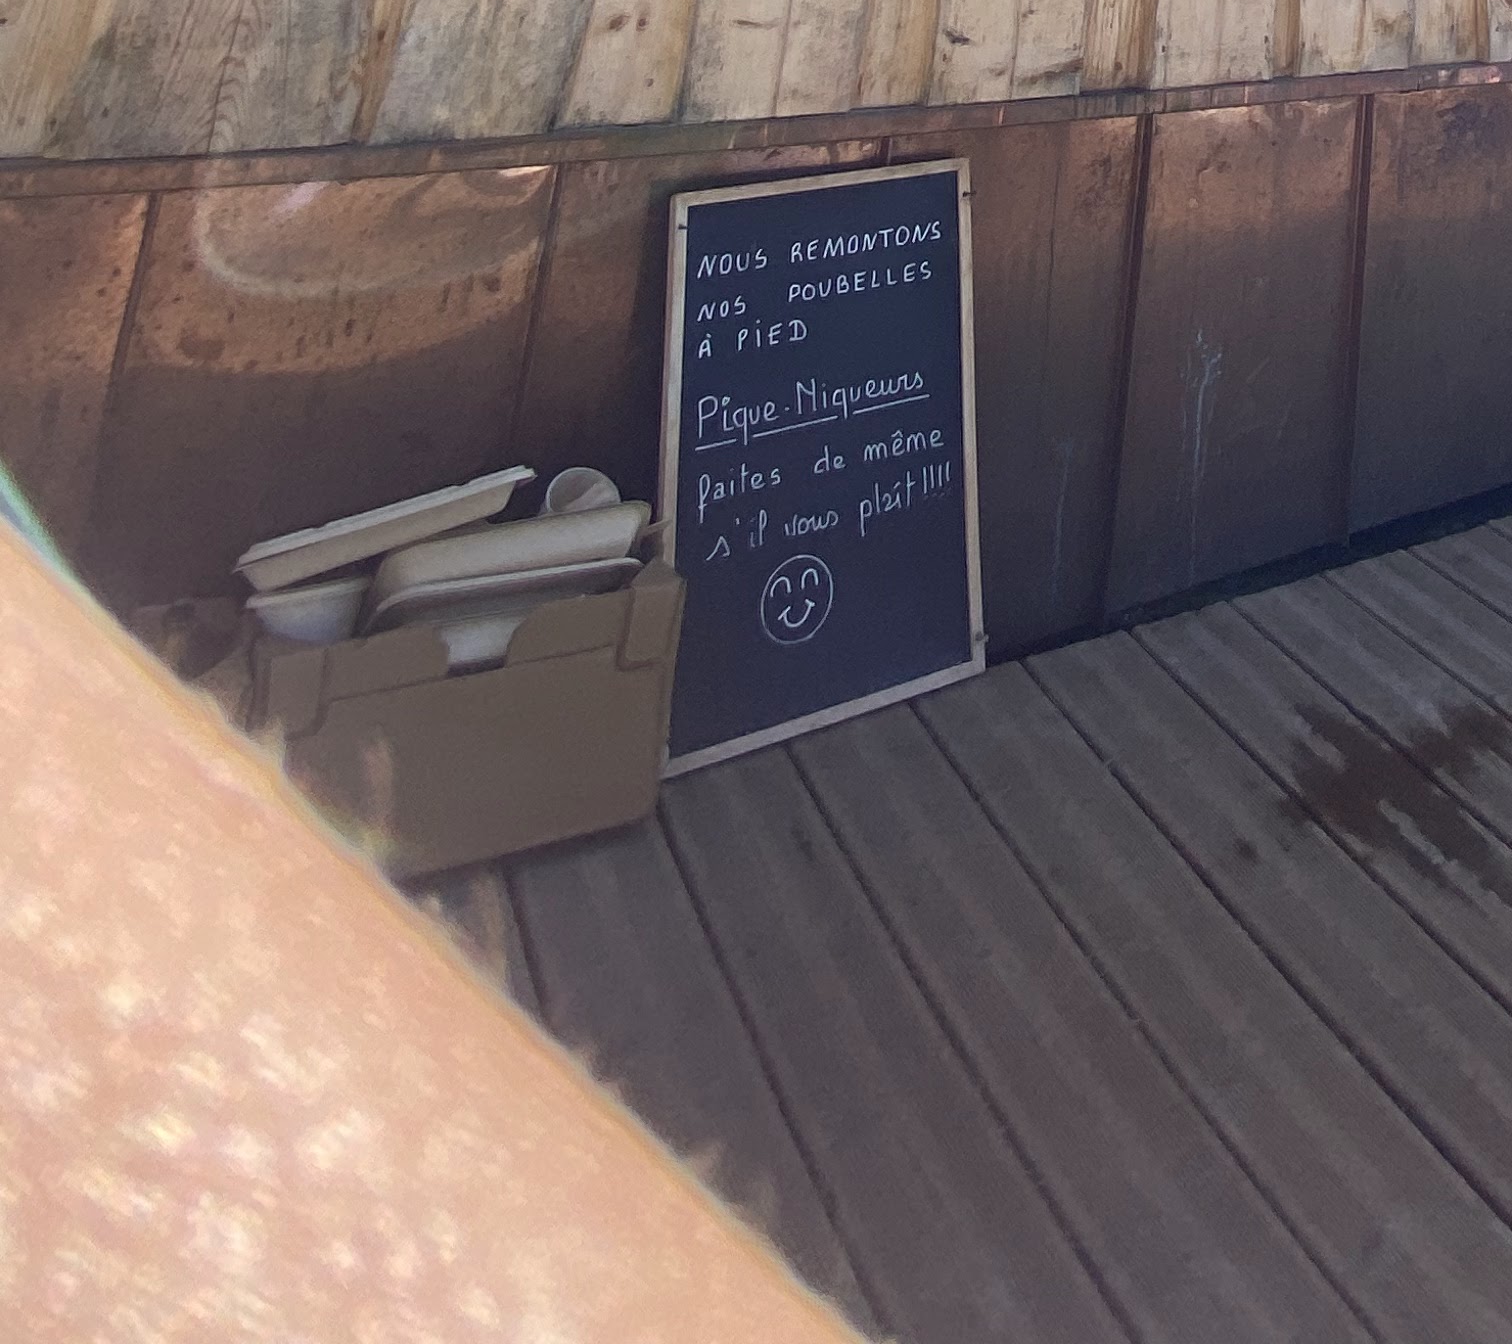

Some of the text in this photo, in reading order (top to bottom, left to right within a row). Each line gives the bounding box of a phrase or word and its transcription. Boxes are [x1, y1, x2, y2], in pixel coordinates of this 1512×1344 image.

[697, 221, 942, 279] NOUS REMONTONS
[697, 261, 933, 322] NOS POUBELLES
[698, 333, 712, 359] À
[698, 429, 945, 524] faites de même
[706, 509, 768, 561] s'il
[784, 510, 839, 537] vous
